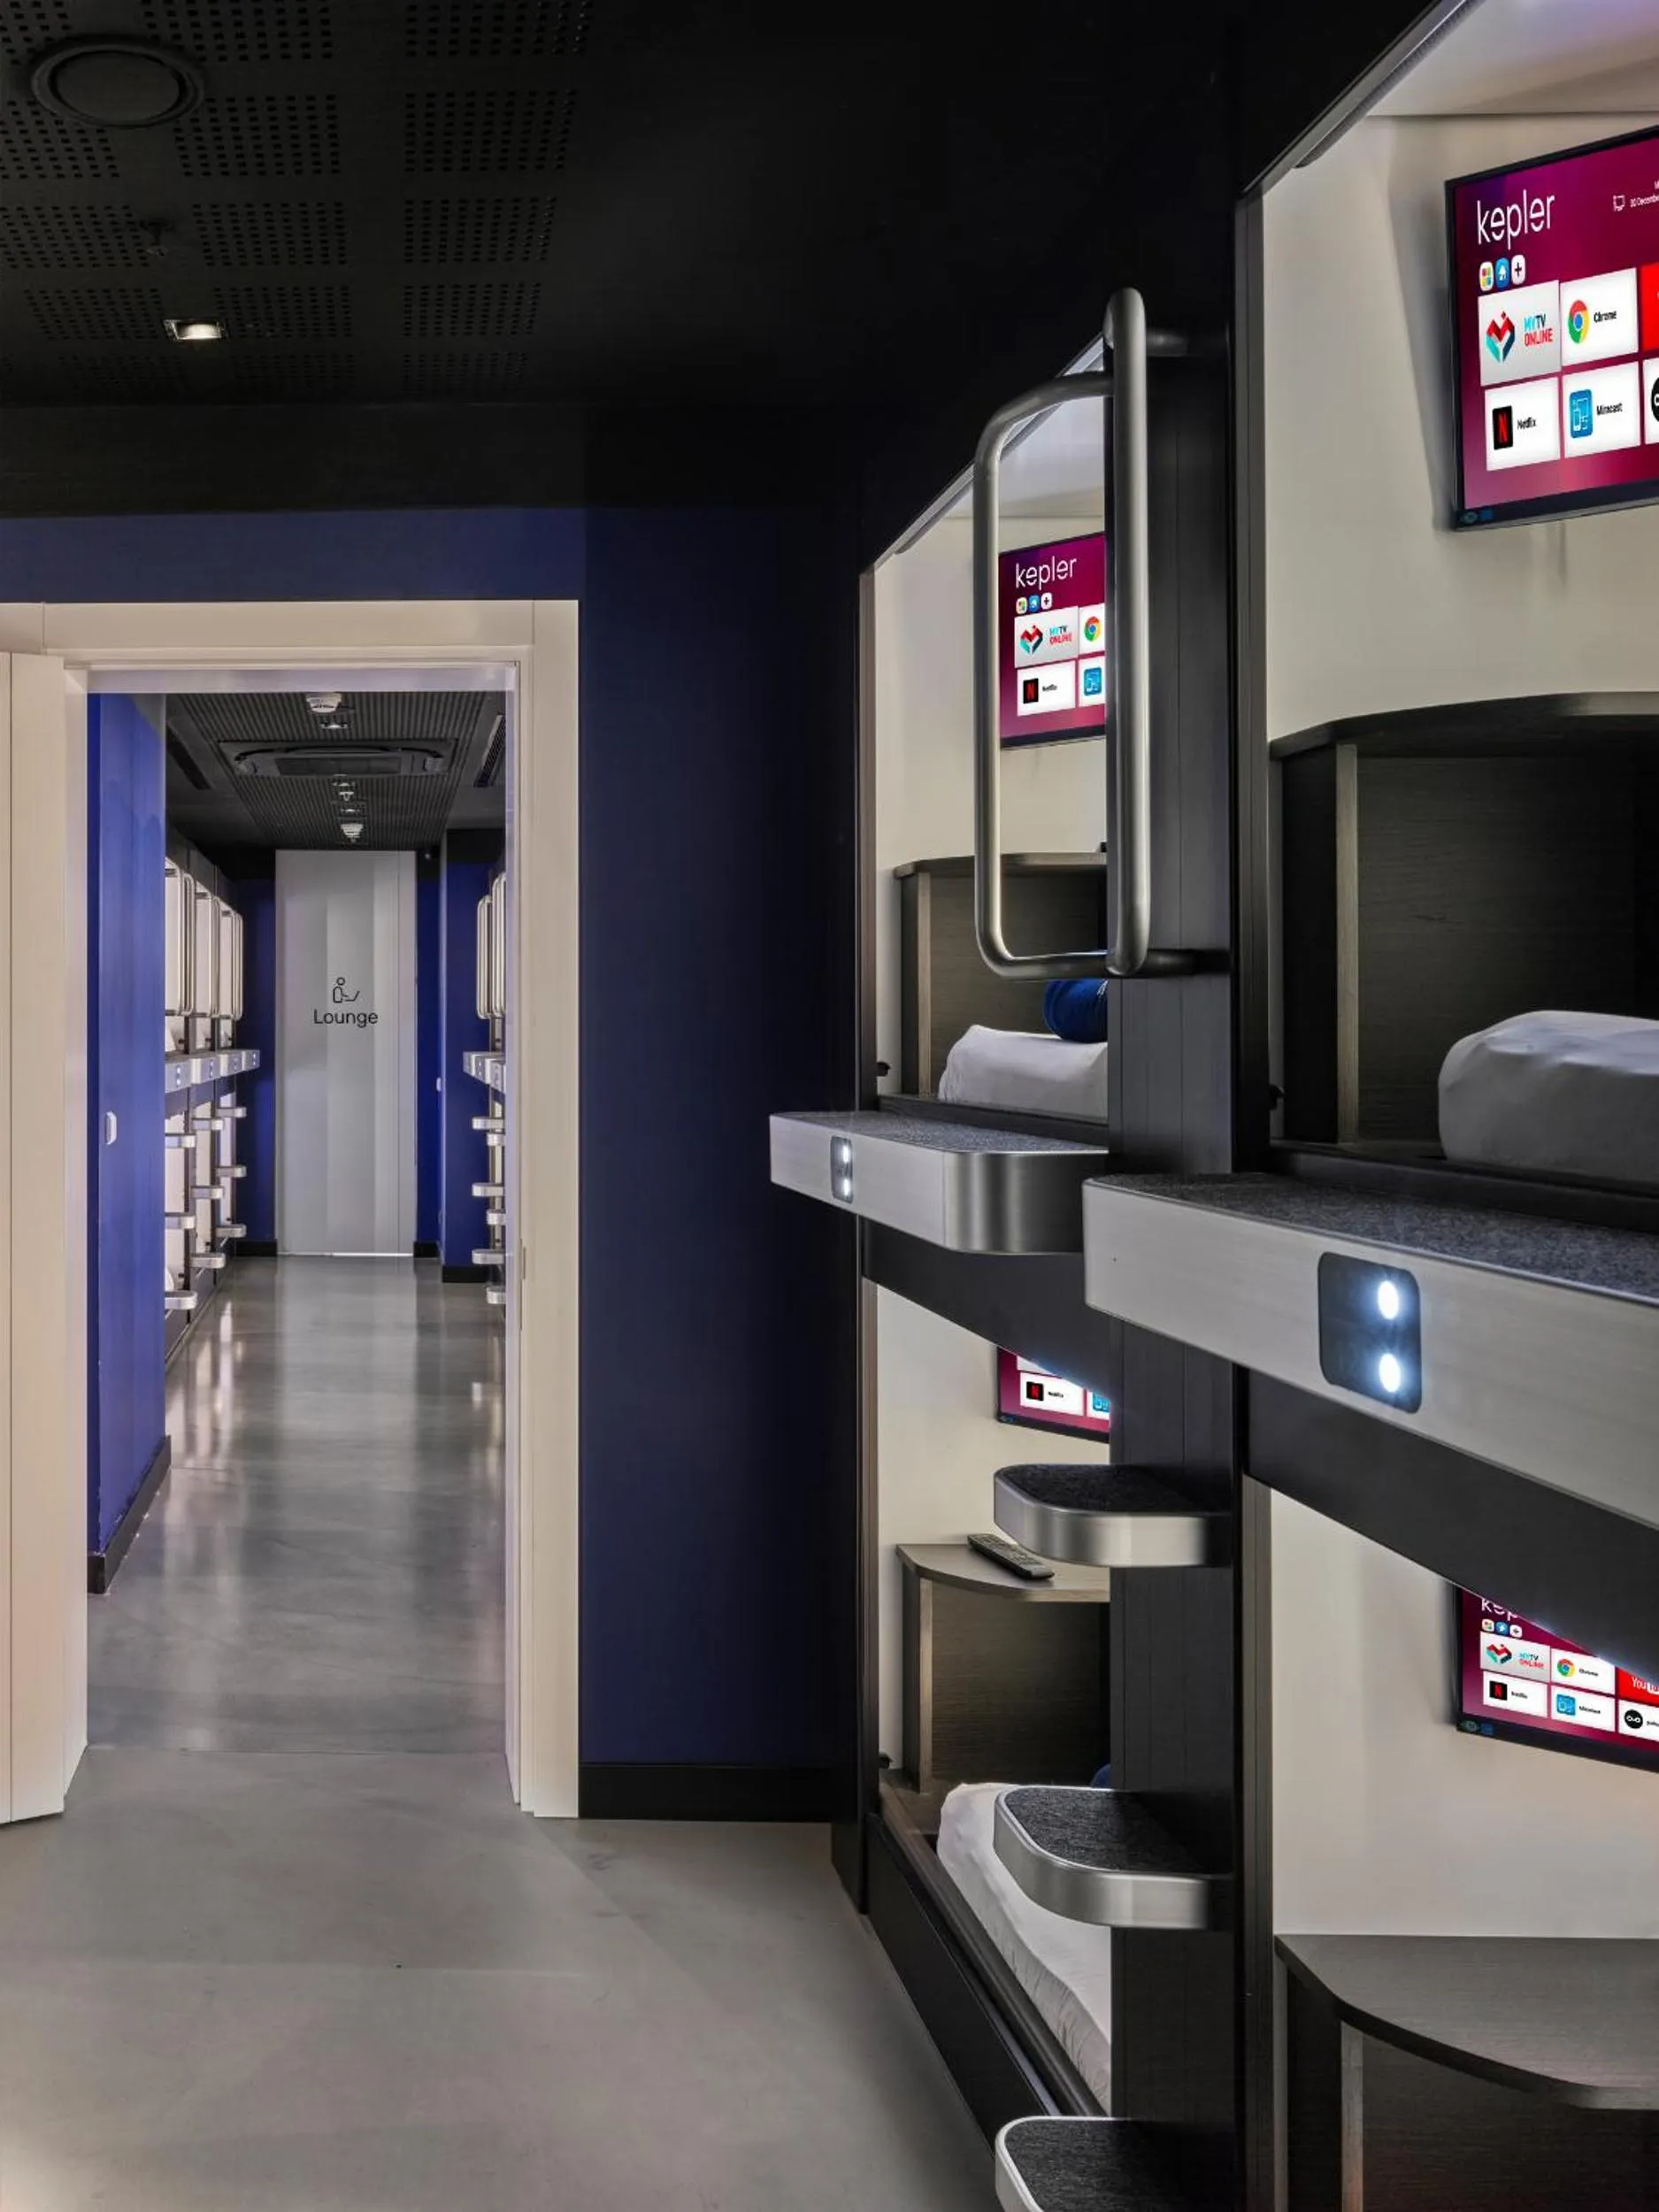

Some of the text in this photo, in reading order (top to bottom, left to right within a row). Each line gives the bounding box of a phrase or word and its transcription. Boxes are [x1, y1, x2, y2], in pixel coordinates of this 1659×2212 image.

[1477, 188, 1555, 250] kepler
[1594, 311, 1617, 324] Chrome
[1524, 327, 1554, 347] ONLINE
[1596, 403, 1623, 416] Miracast
[1016, 556, 1077, 590] kepler
[313, 1009, 379, 1029] Lounge
